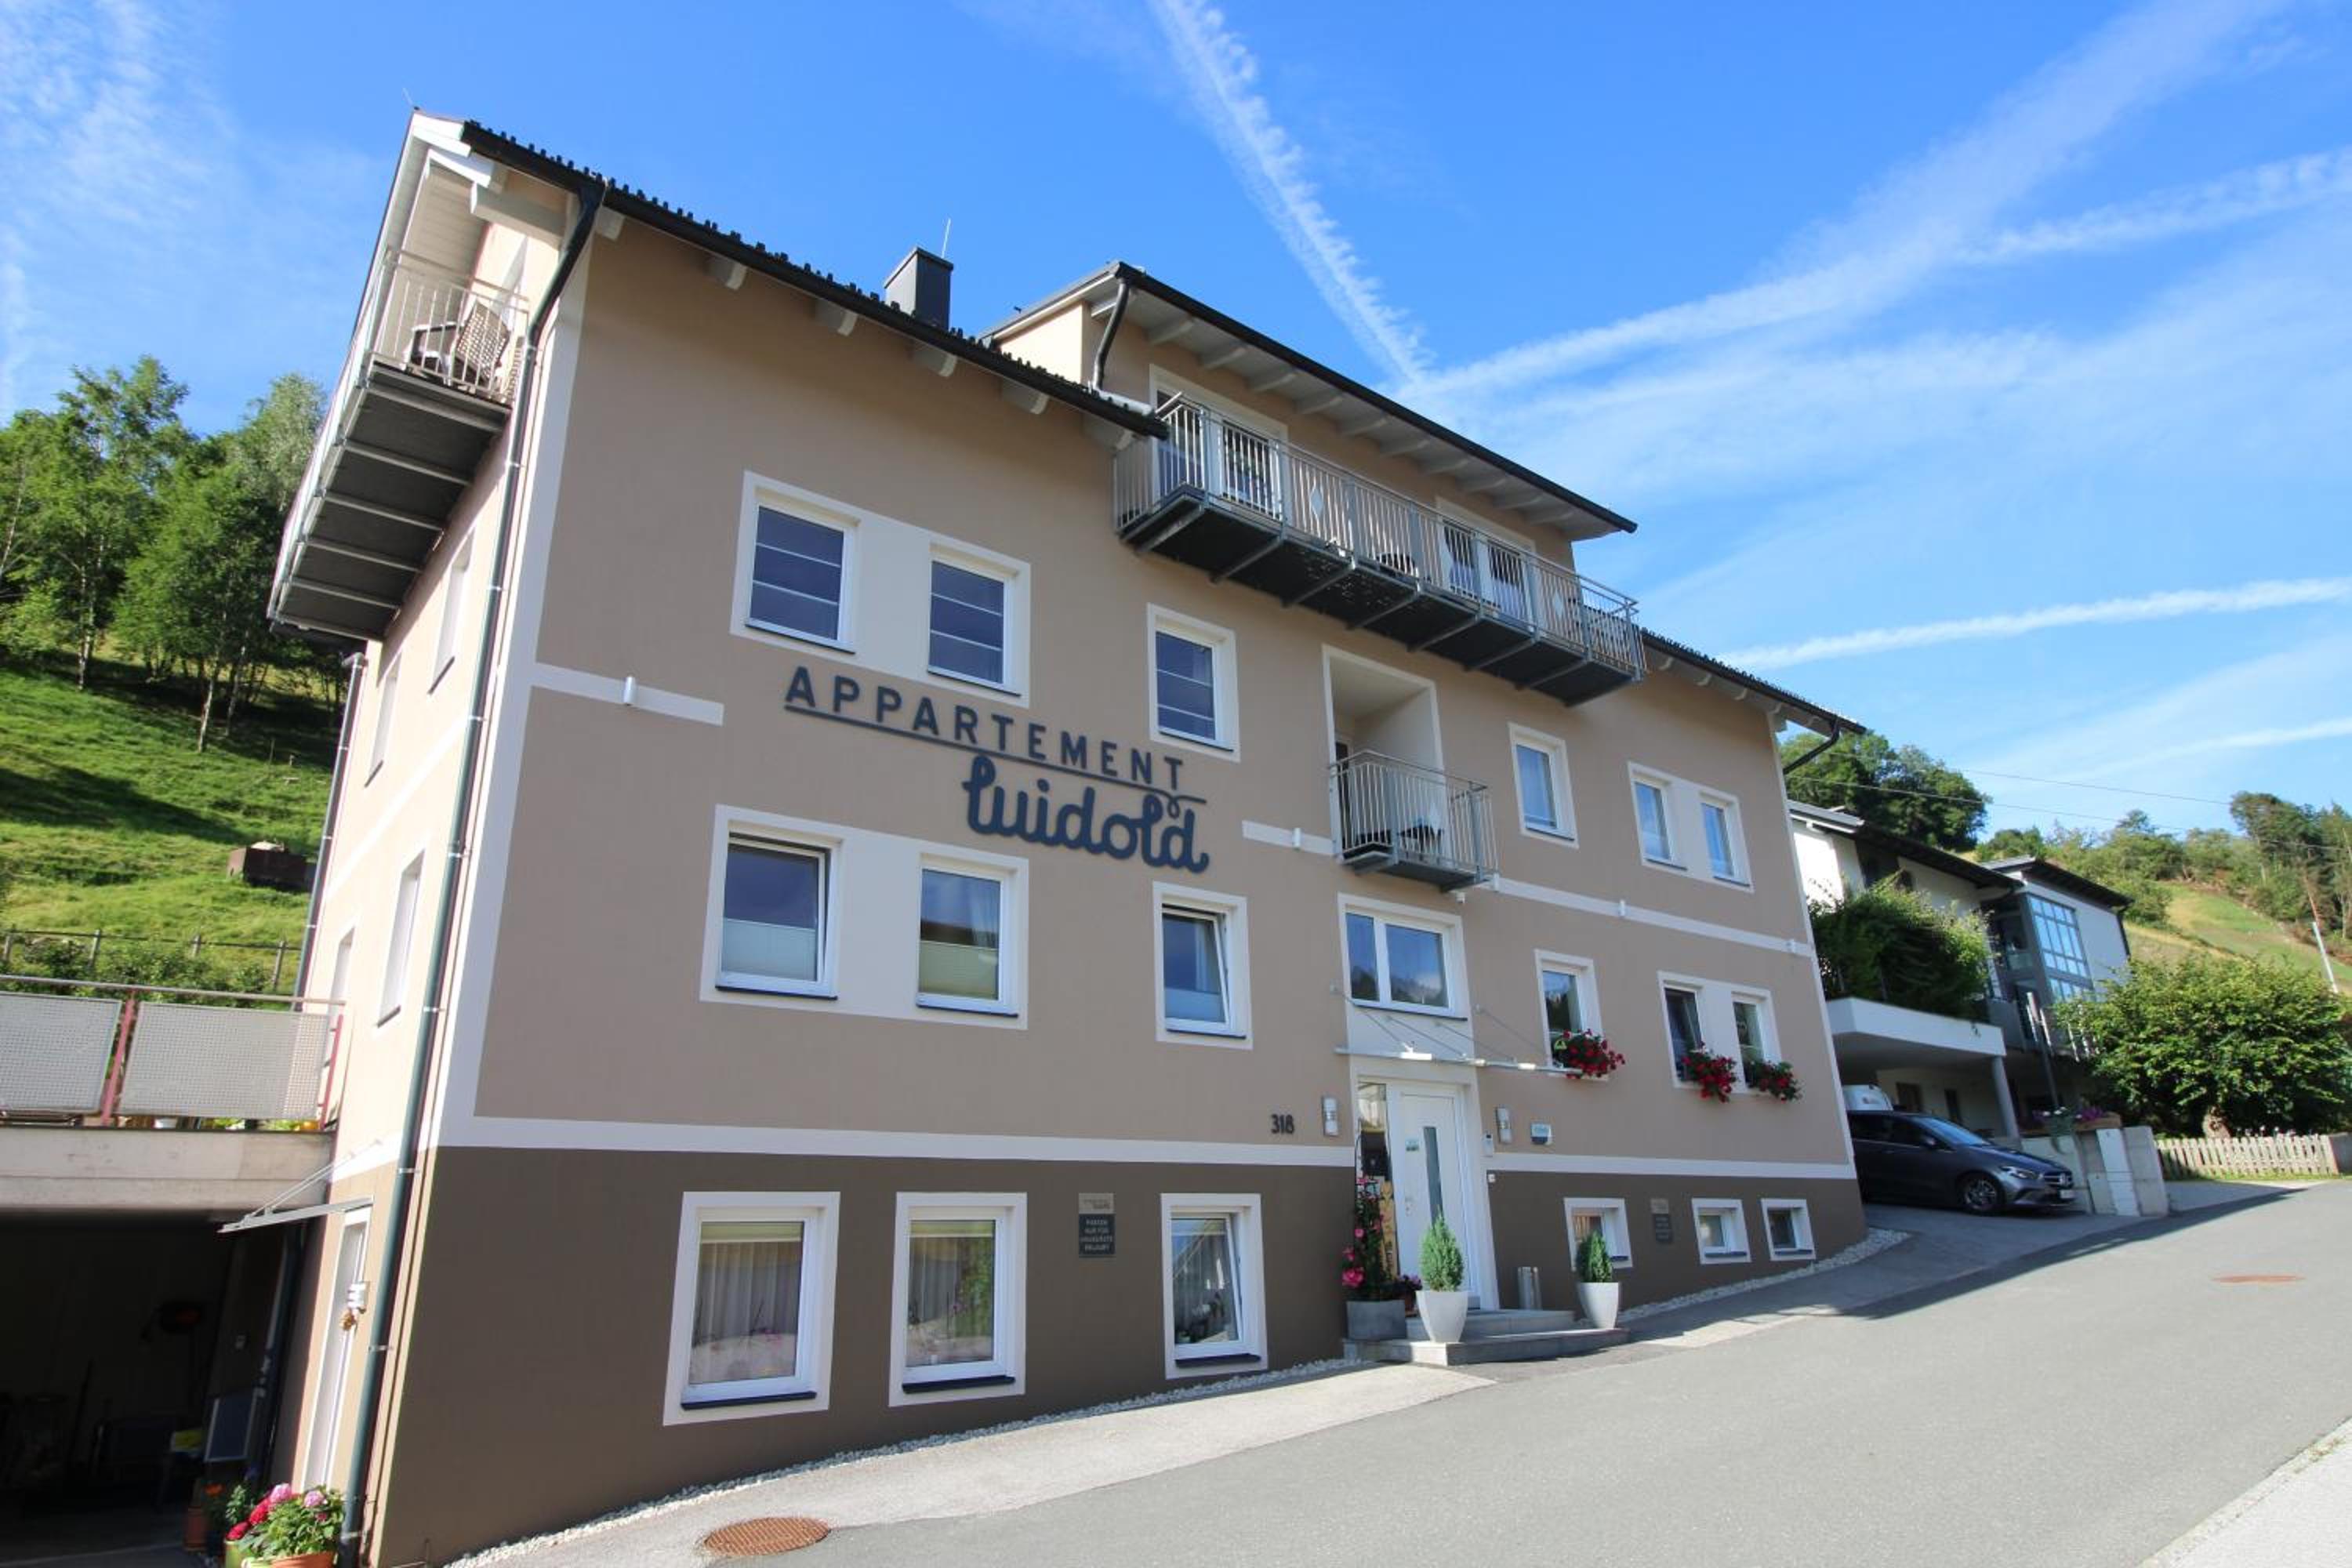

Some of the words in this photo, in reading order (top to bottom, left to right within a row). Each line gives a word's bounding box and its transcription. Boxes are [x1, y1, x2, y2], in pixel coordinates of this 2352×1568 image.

[784, 666, 1184, 791] APPARTEMENT
[962, 755, 1210, 875] Luidold
[1271, 1113, 1295, 1135] 318
